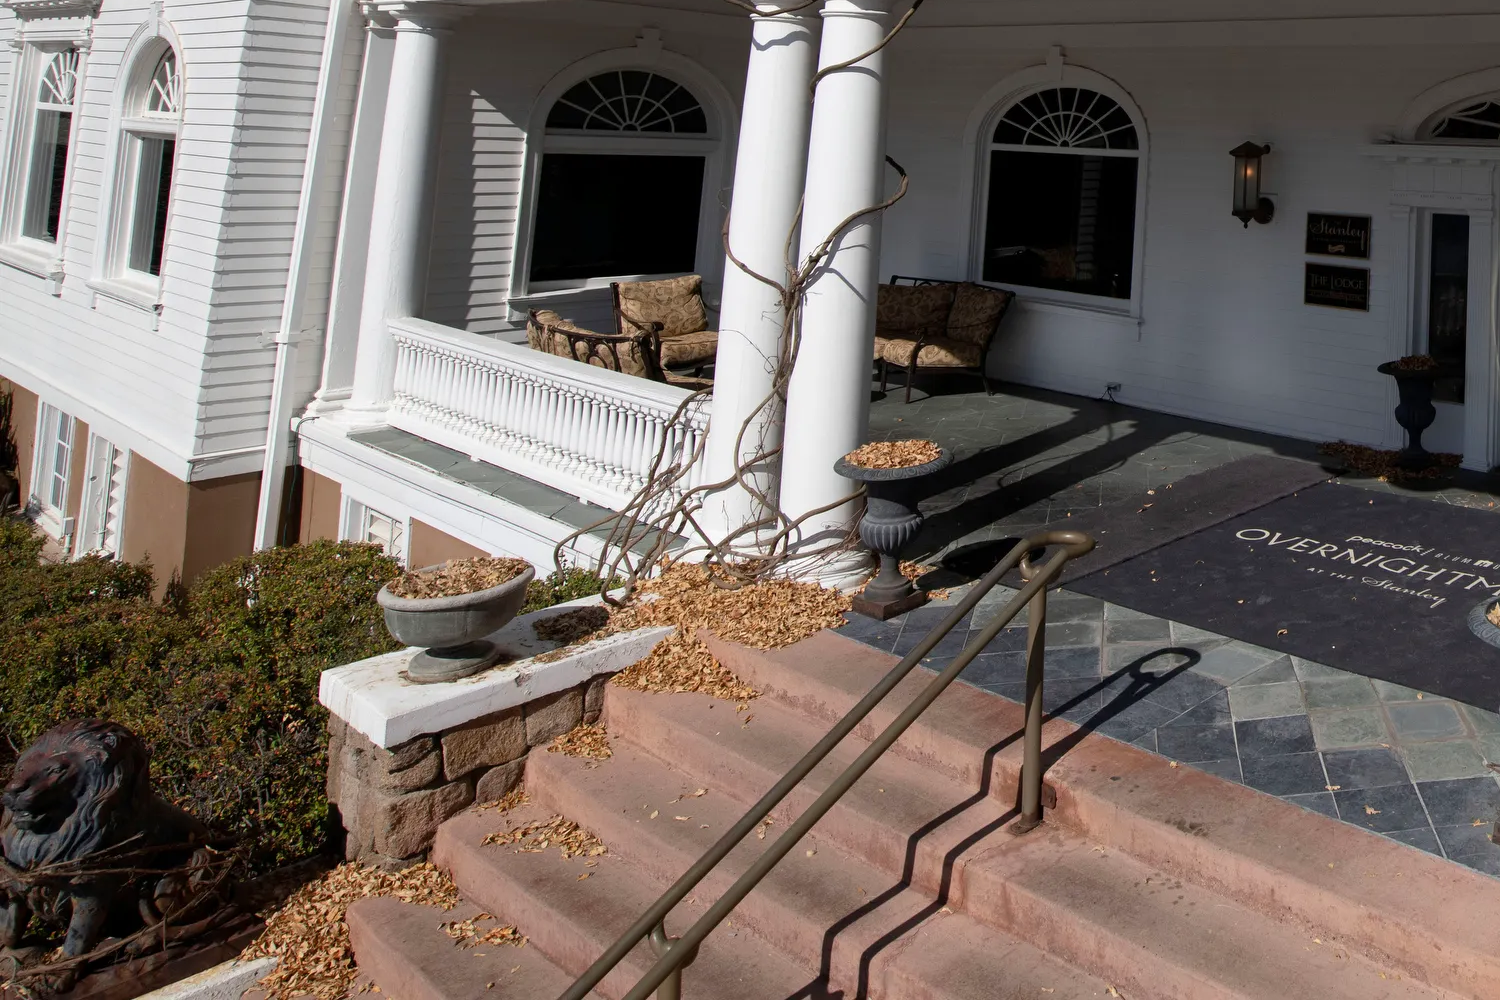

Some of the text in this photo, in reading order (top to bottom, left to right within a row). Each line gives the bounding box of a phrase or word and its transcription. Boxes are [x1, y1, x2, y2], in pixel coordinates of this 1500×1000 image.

[1309, 217, 1366, 251] Stanley
[1345, 535, 1424, 553] peacock
[1329, 572, 1355, 580] THE
[1361, 576, 1447, 609] Stanley
